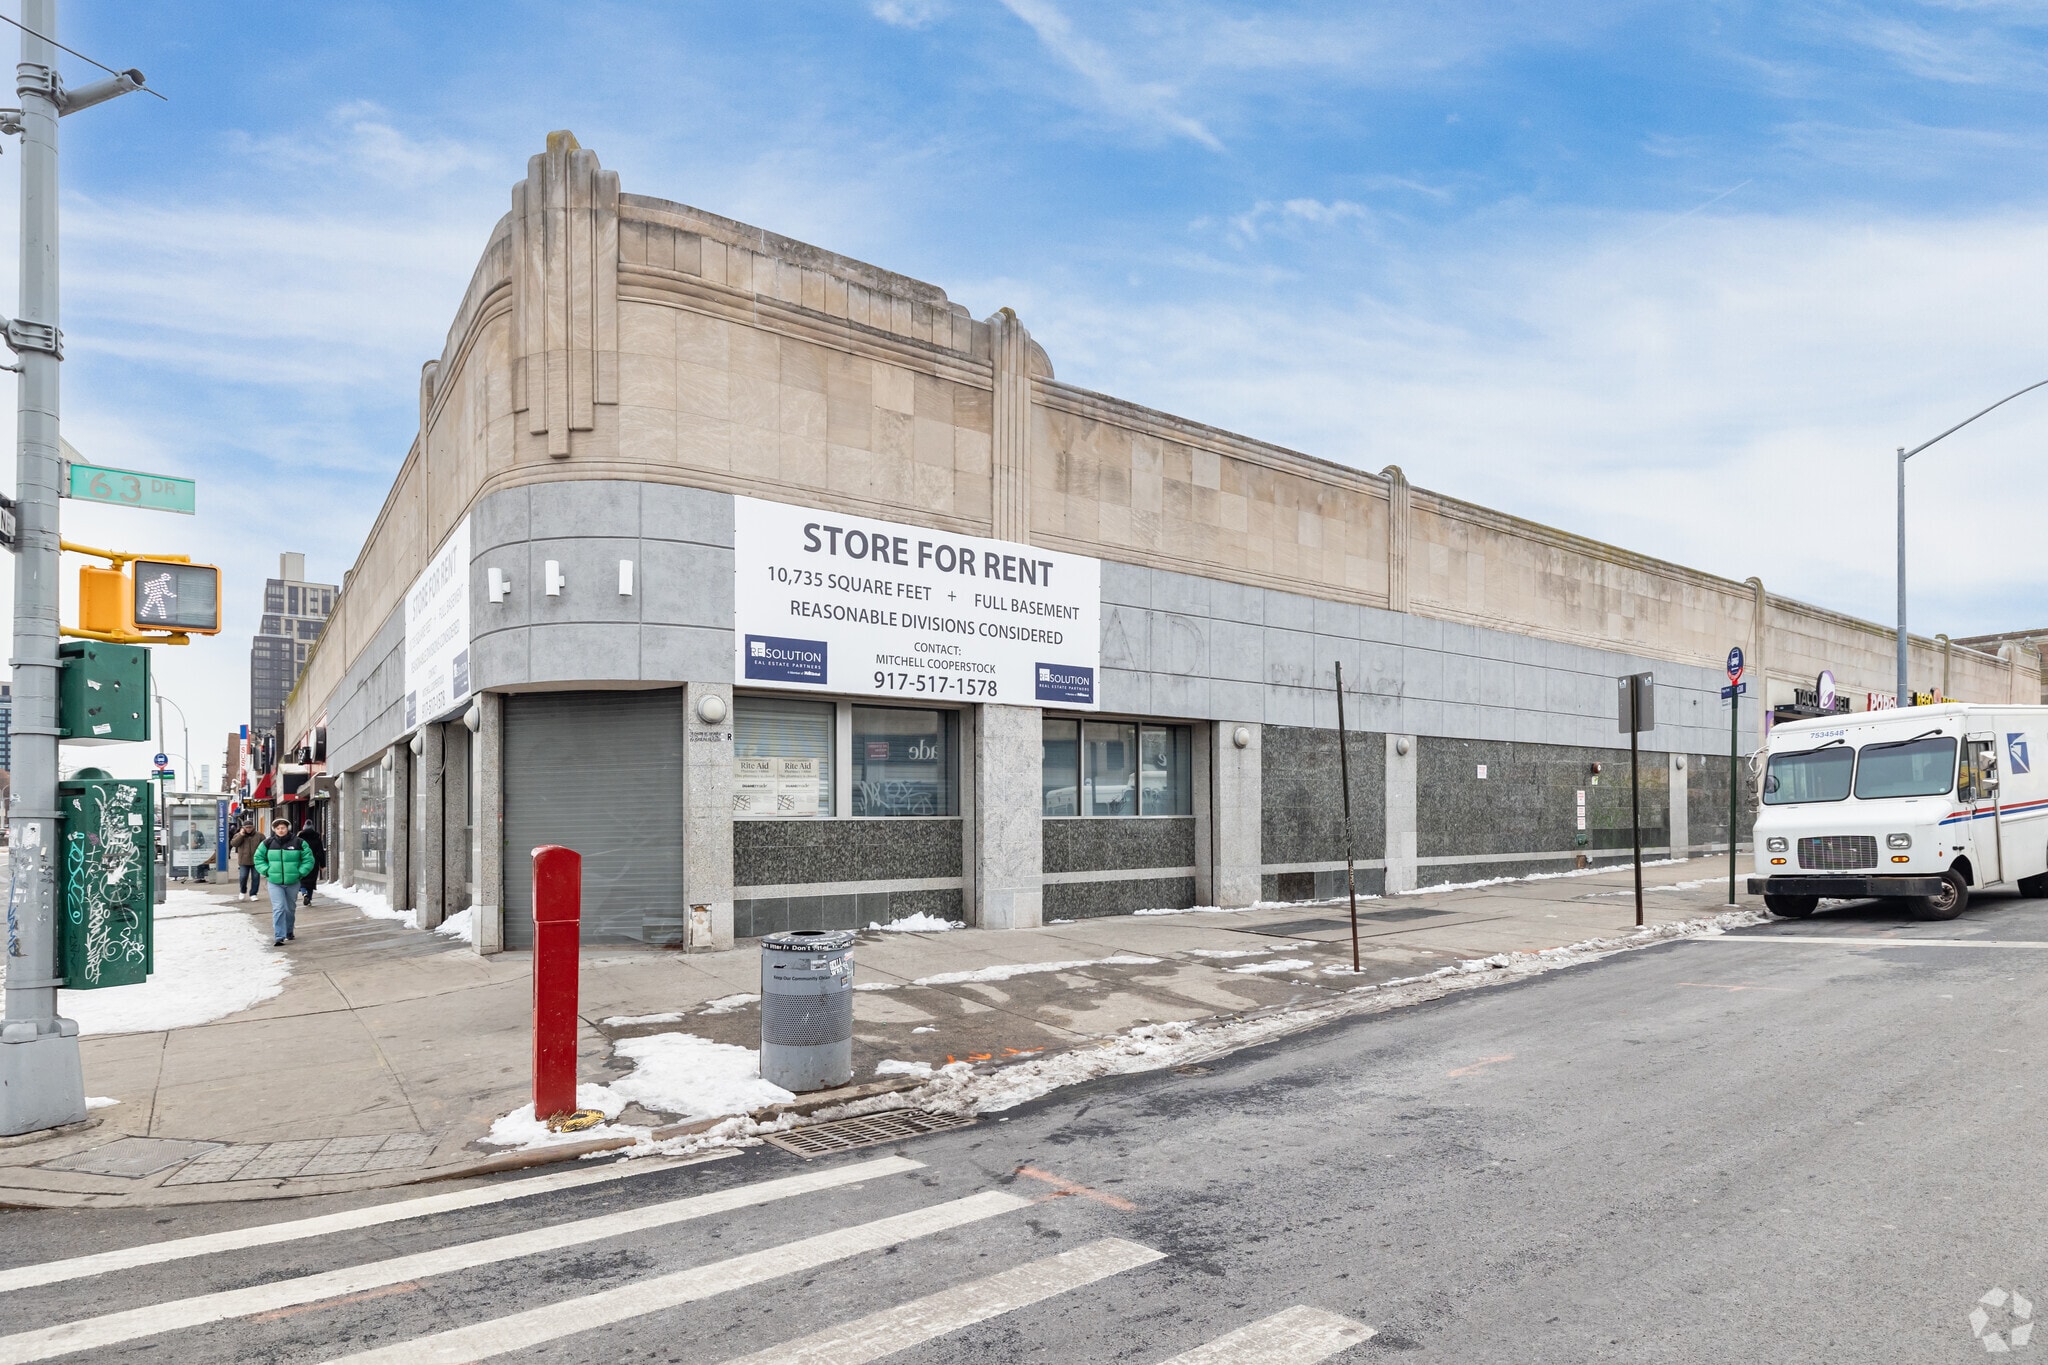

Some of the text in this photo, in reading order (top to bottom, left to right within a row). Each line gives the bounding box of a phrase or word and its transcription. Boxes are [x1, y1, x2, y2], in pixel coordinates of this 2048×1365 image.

[90, 472, 176, 503] 63 DR
[803, 522, 1054, 587] STORE FOR RENT
[768, 566, 823, 587] 10,735
[828, 573, 893, 597] SQUARE
[897, 583, 932, 601] FEET
[975, 593, 1008, 611] FULL
[1011, 598, 1080, 620] BASEMENT
[790, 600, 1063, 645] REASONABLE DIVISIONS CONSIDERED
[914, 641, 962, 656] CONTACT:
[876, 653, 996, 674] MITCHELL COOPERSTOCK
[874, 671, 998, 697] 917-517-1578
[1794, 688, 1850, 713] TACO BELL
[741, 762, 769, 770] Rite Aid
[784, 762, 812, 770] Rite Aid
